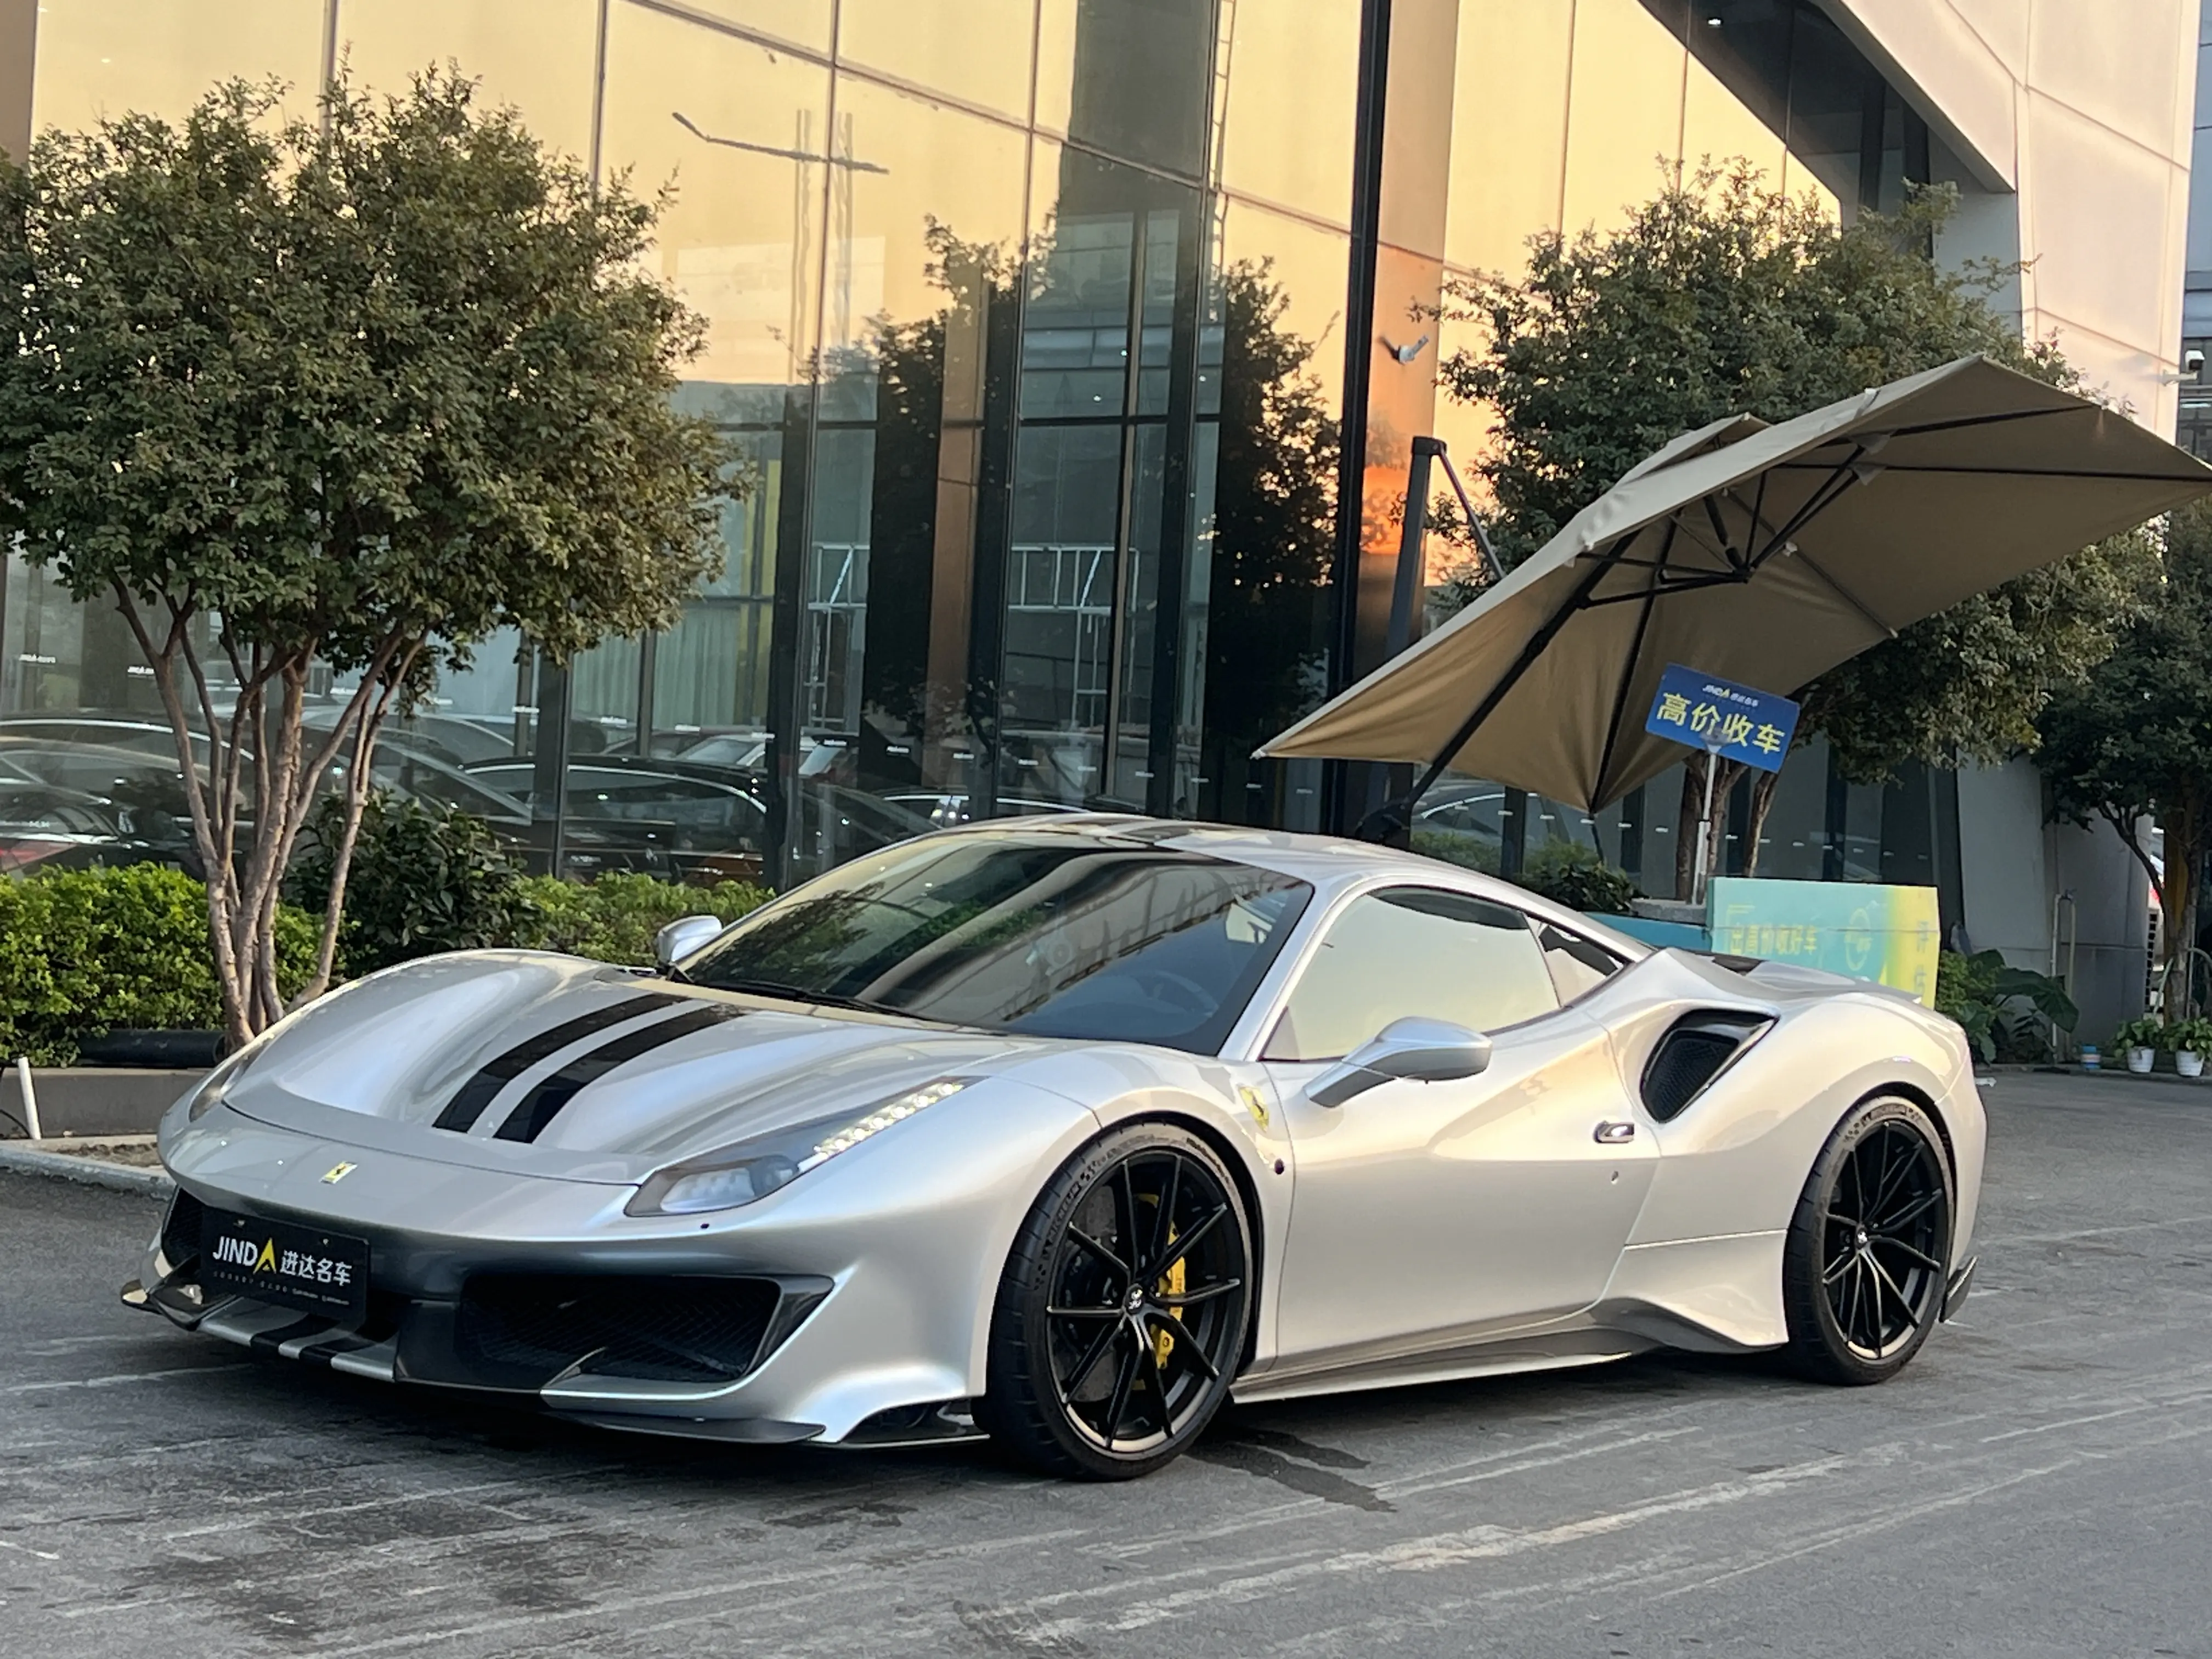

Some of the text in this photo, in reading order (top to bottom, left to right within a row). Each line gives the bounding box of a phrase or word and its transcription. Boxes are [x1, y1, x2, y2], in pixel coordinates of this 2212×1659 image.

[1656, 693, 1785, 753] 高价收车
[213, 1237, 276, 1274] JINDA
